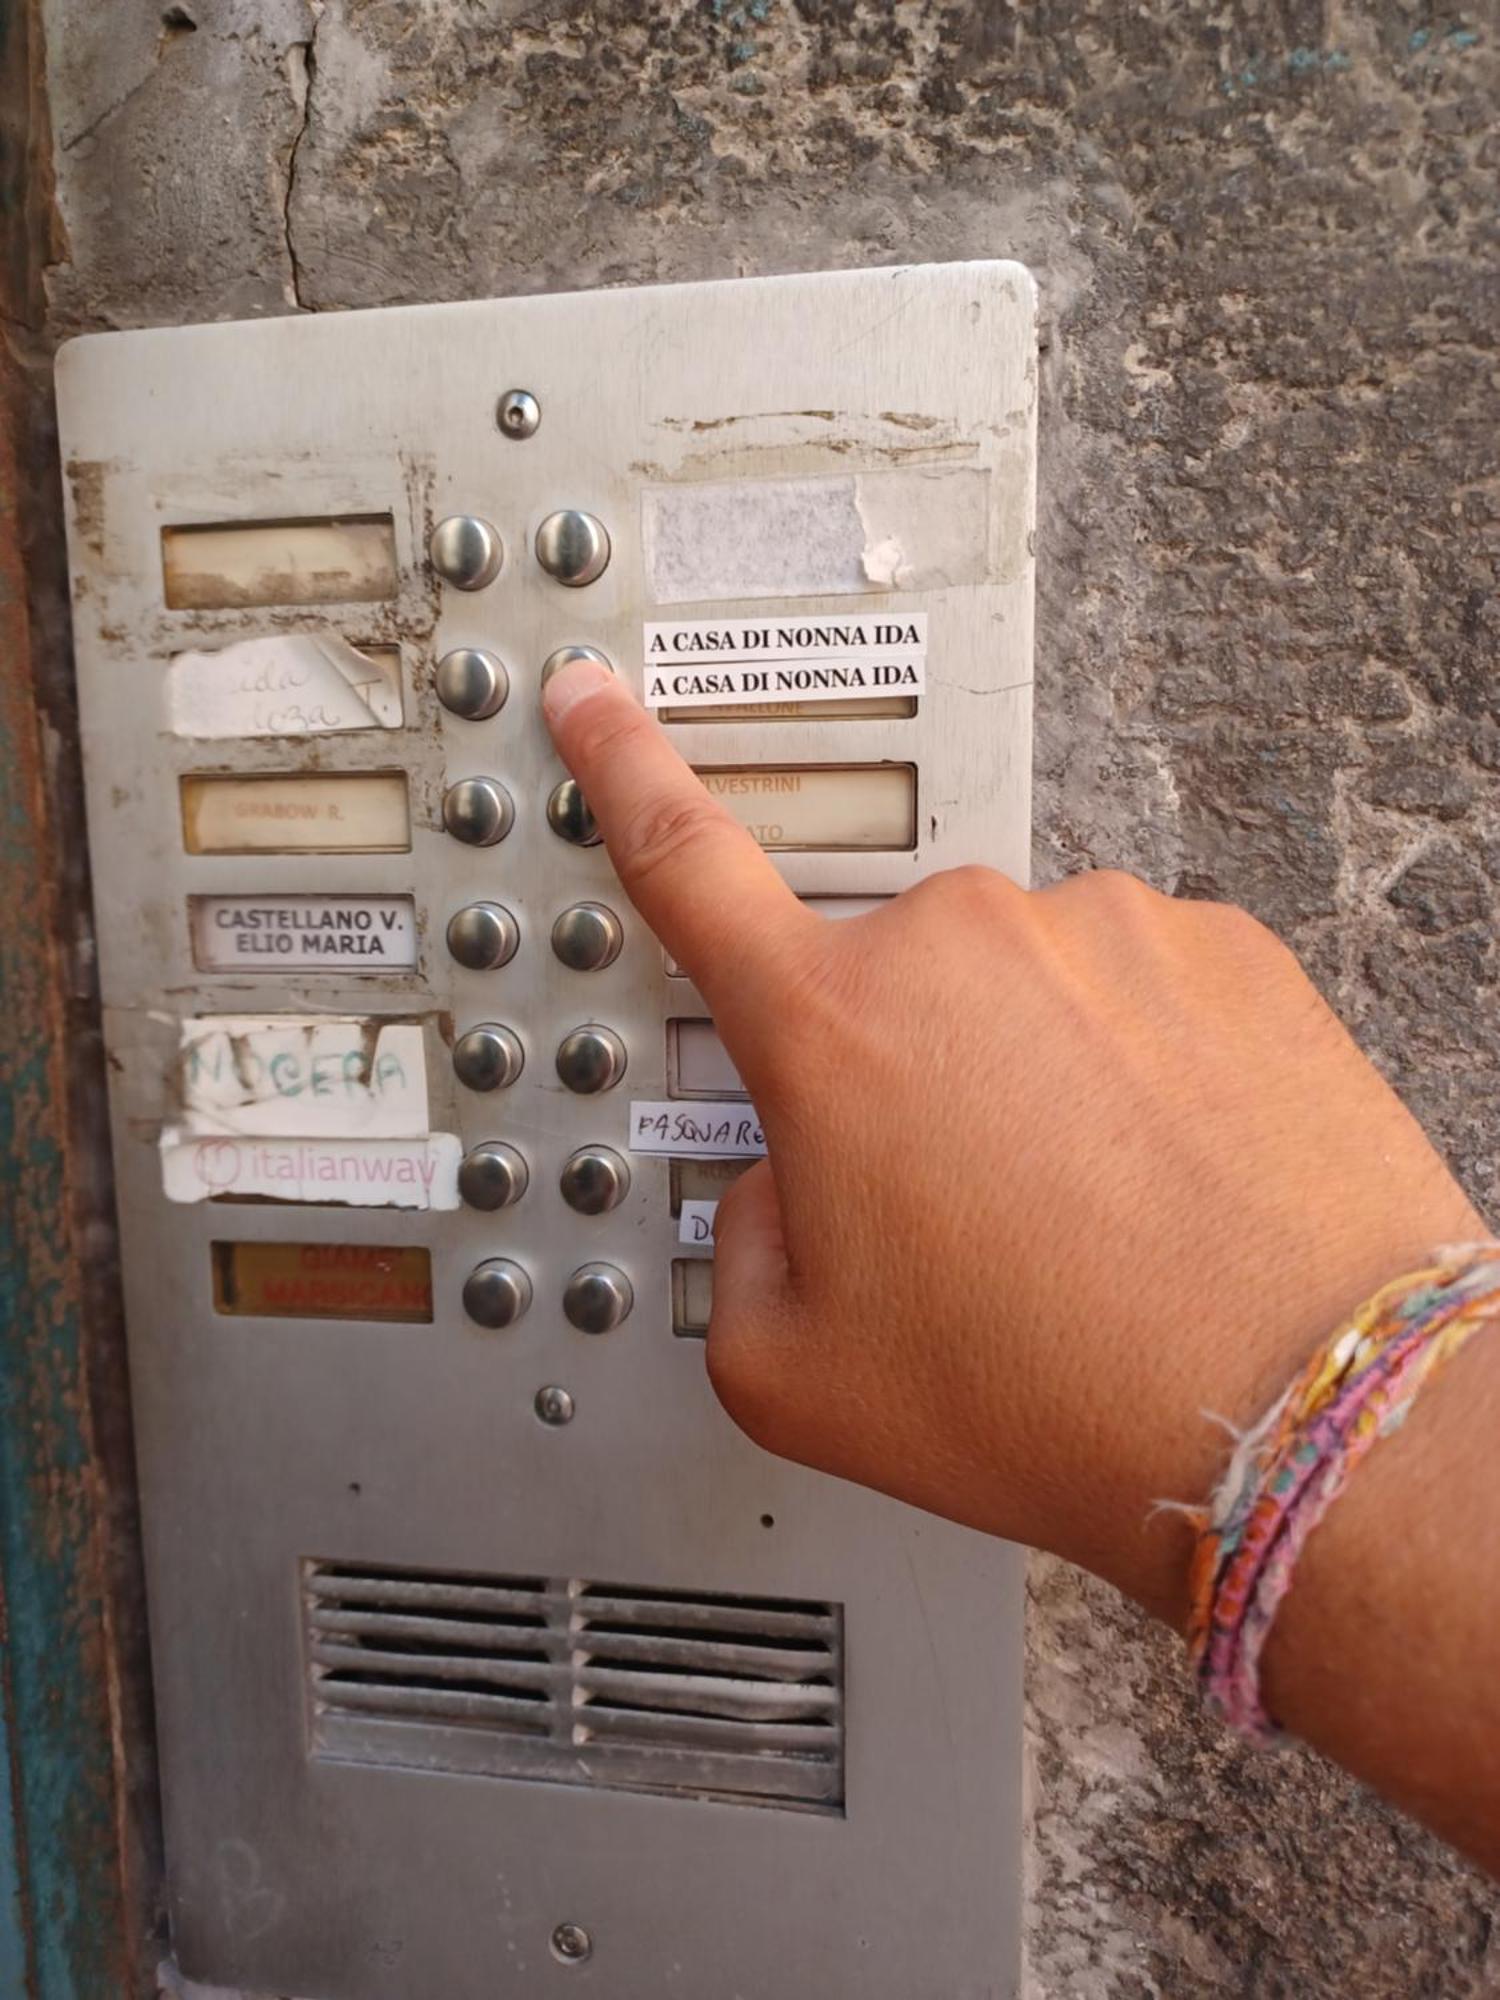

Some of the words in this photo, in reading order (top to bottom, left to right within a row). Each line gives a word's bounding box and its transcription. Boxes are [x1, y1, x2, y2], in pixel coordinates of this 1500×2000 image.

[650, 633, 667, 652] A
[673, 631, 736, 651] CASA
[742, 629, 771, 649] DI
[776, 626, 867, 648] NONNA
[874, 624, 920, 645] IDA
[650, 677, 667, 696] A
[673, 674, 736, 695] CASA
[742, 672, 769, 692] DI
[775, 667, 866, 691] NONNA
[872, 665, 918, 686] IDA
[215, 908, 372, 930] CASTELLANO
[380, 910, 403, 930] V.
[236, 932, 294, 953] ELIO
[302, 934, 385, 954] MARIA
[252, 1147, 440, 1188] italianway
